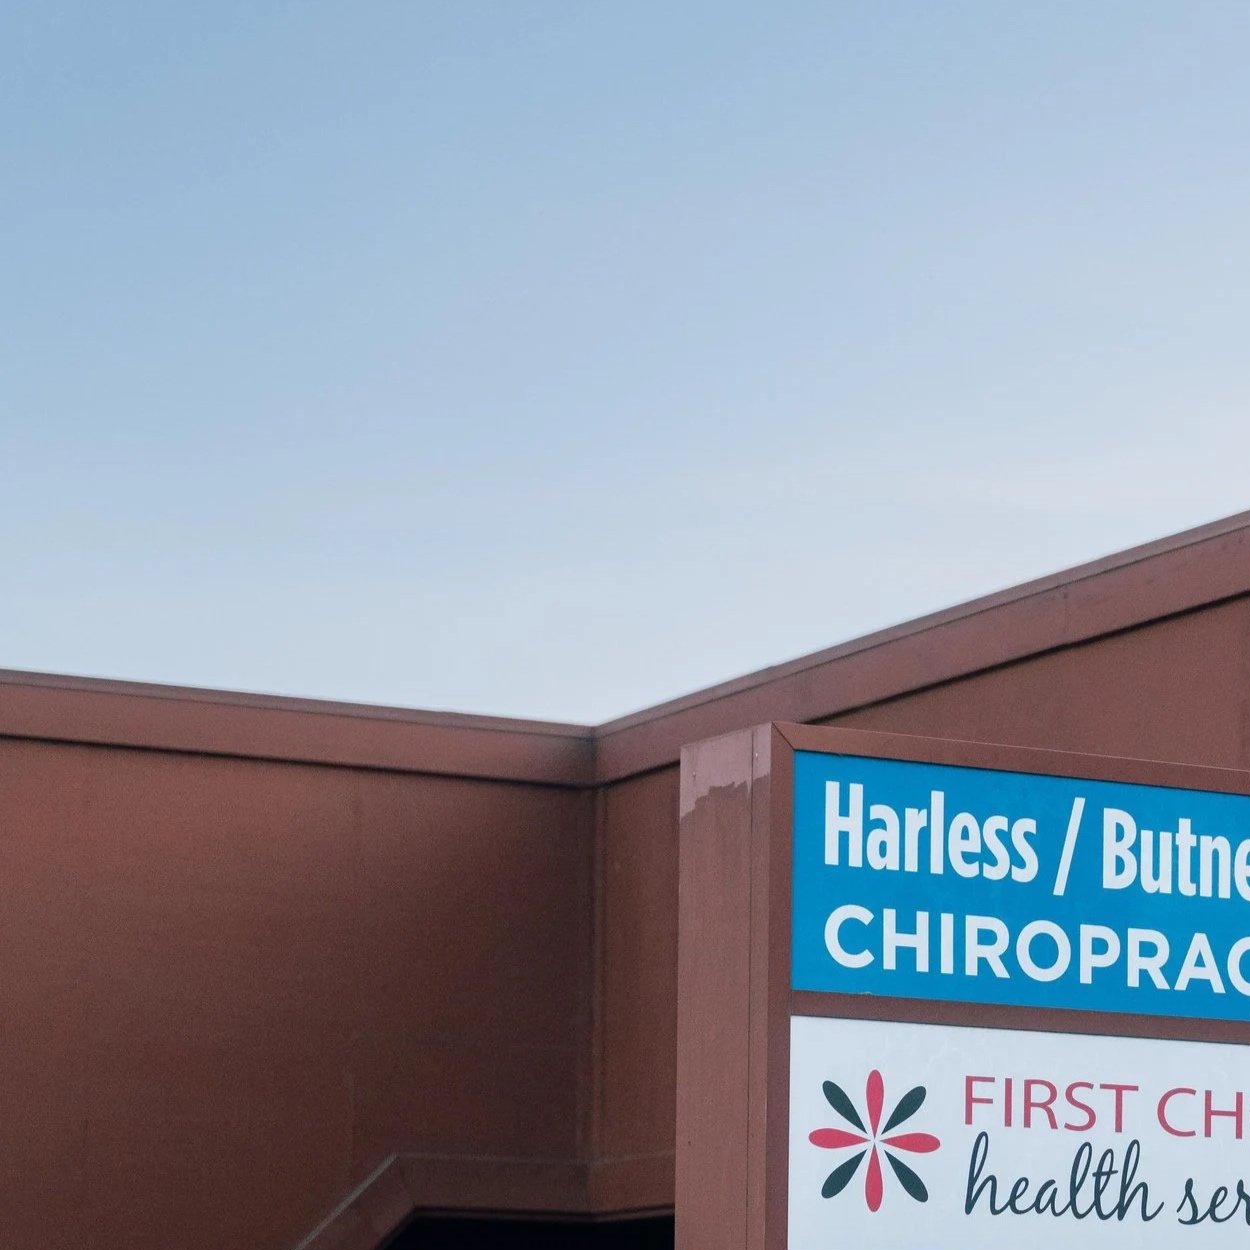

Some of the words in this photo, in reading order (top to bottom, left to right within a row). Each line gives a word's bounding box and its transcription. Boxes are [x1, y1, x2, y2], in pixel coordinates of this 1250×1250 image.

[824, 781, 1038, 883] Harless
[1053, 797, 1086, 896] /
[964, 1075, 1139, 1135] FIRST
[964, 1131, 1164, 1222] health
